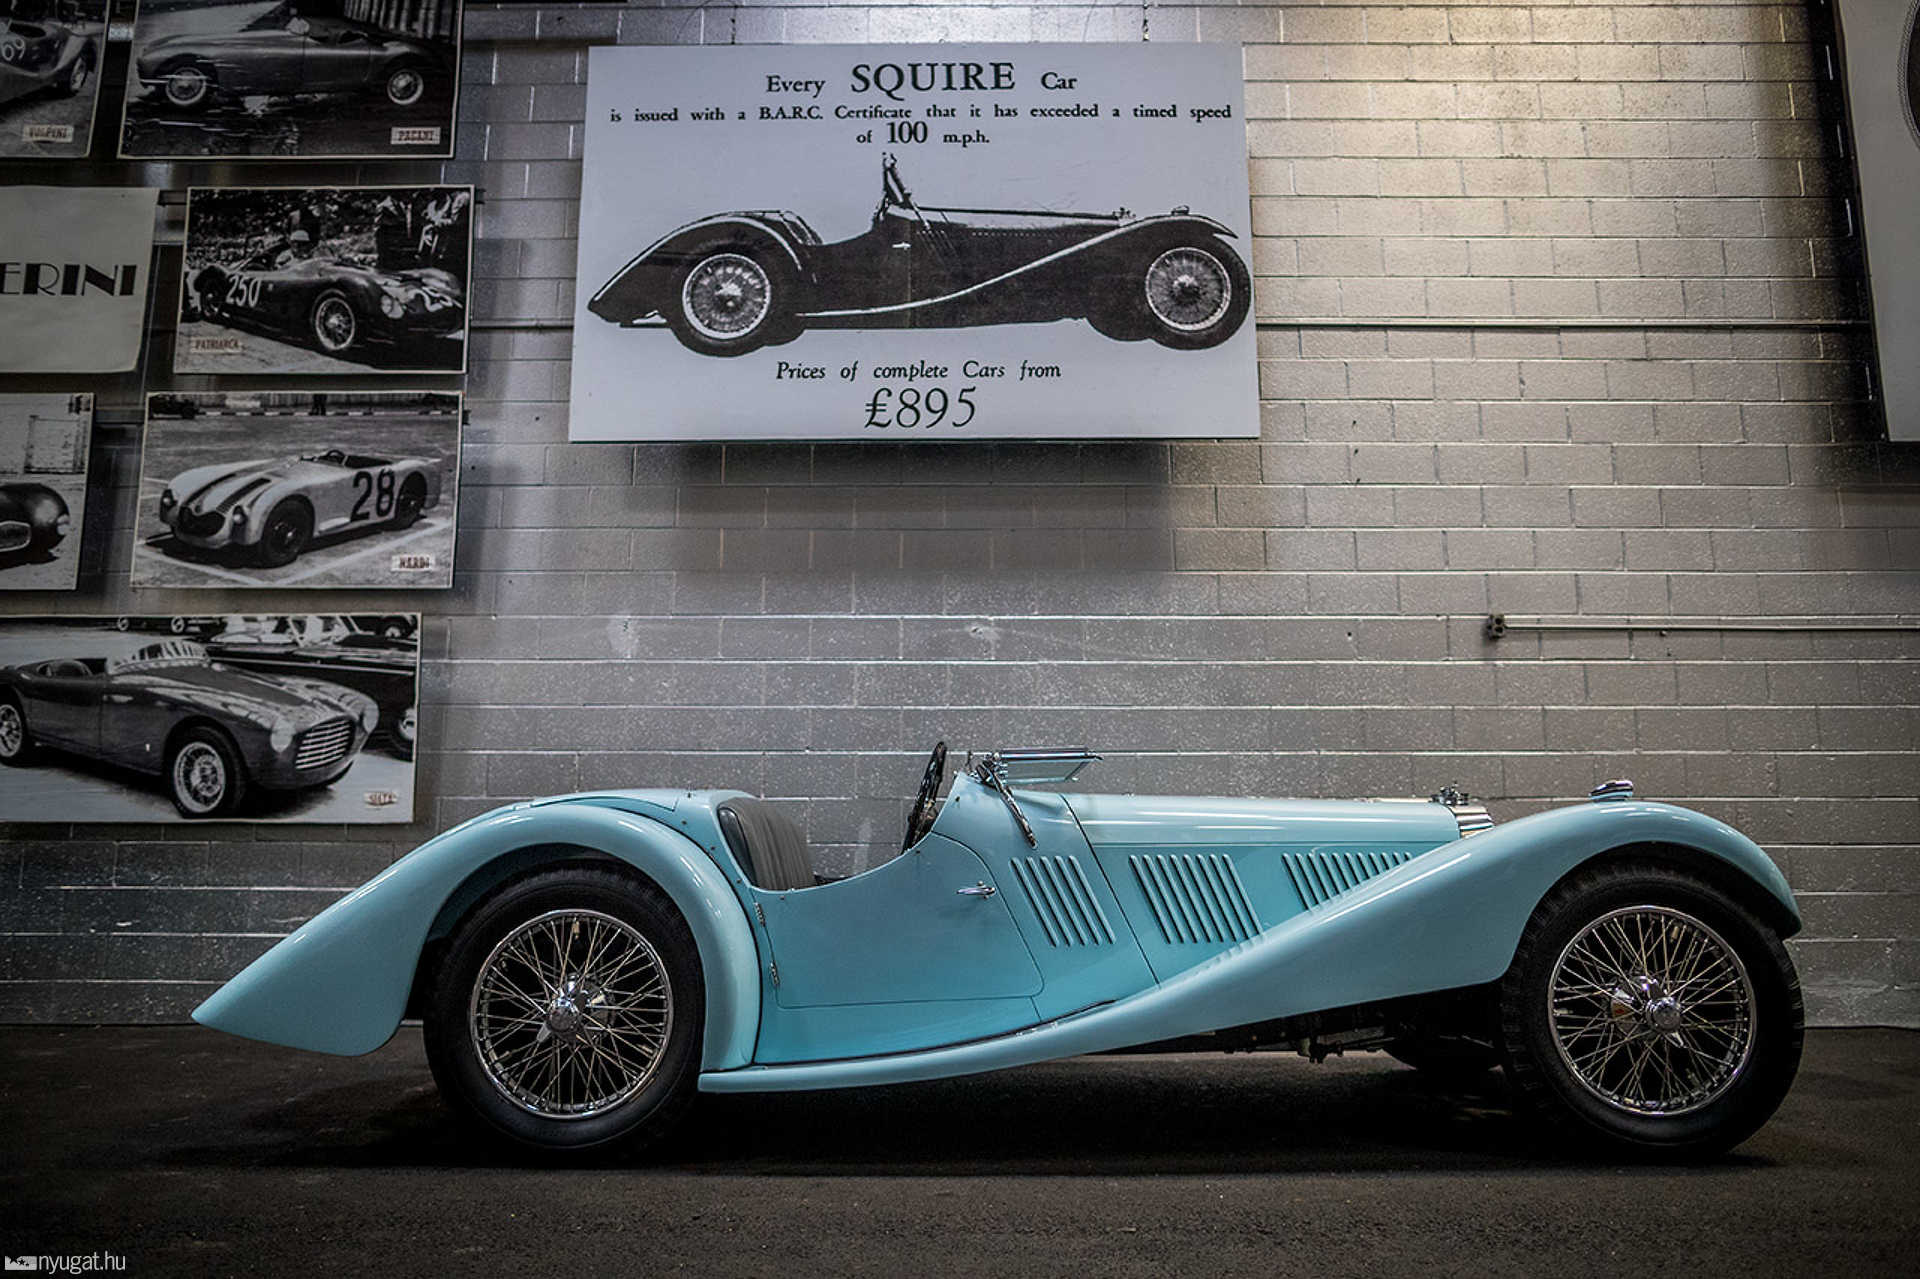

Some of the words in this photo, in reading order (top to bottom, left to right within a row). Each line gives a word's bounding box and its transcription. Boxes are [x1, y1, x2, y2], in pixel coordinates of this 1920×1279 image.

[766, 75, 826, 98] Every
[850, 61, 1016, 101] SQUIRE
[1040, 72, 1078, 91] Car
[610, 109, 622, 122] is
[634, 108, 679, 122] issued
[690, 107, 725, 121] with
[737, 111, 747, 121] a
[759, 106, 824, 120] B.A.R.C.
[834, 104, 912, 119] Certificate
[926, 104, 956, 118] that
[970, 104, 982, 118] it
[994, 104, 1018, 118] has
[1030, 103, 1099, 118] exceeded
[1112, 108, 1121, 118] a
[1133, 104, 1178, 118] timed
[1190, 104, 1232, 123] speed
[856, 130, 873, 144] of
[886, 121, 928, 144] 100
[943, 130, 990, 148] m.p.h.
[226, 274, 262, 307] 250
[776, 361, 826, 380] Prices
[840, 359, 858, 382] of
[874, 359, 948, 382] complete
[963, 360, 1005, 379] Cars
[1020, 359, 1062, 382] from
[864, 386, 977, 429] £895
[350, 469, 395, 522] 28
